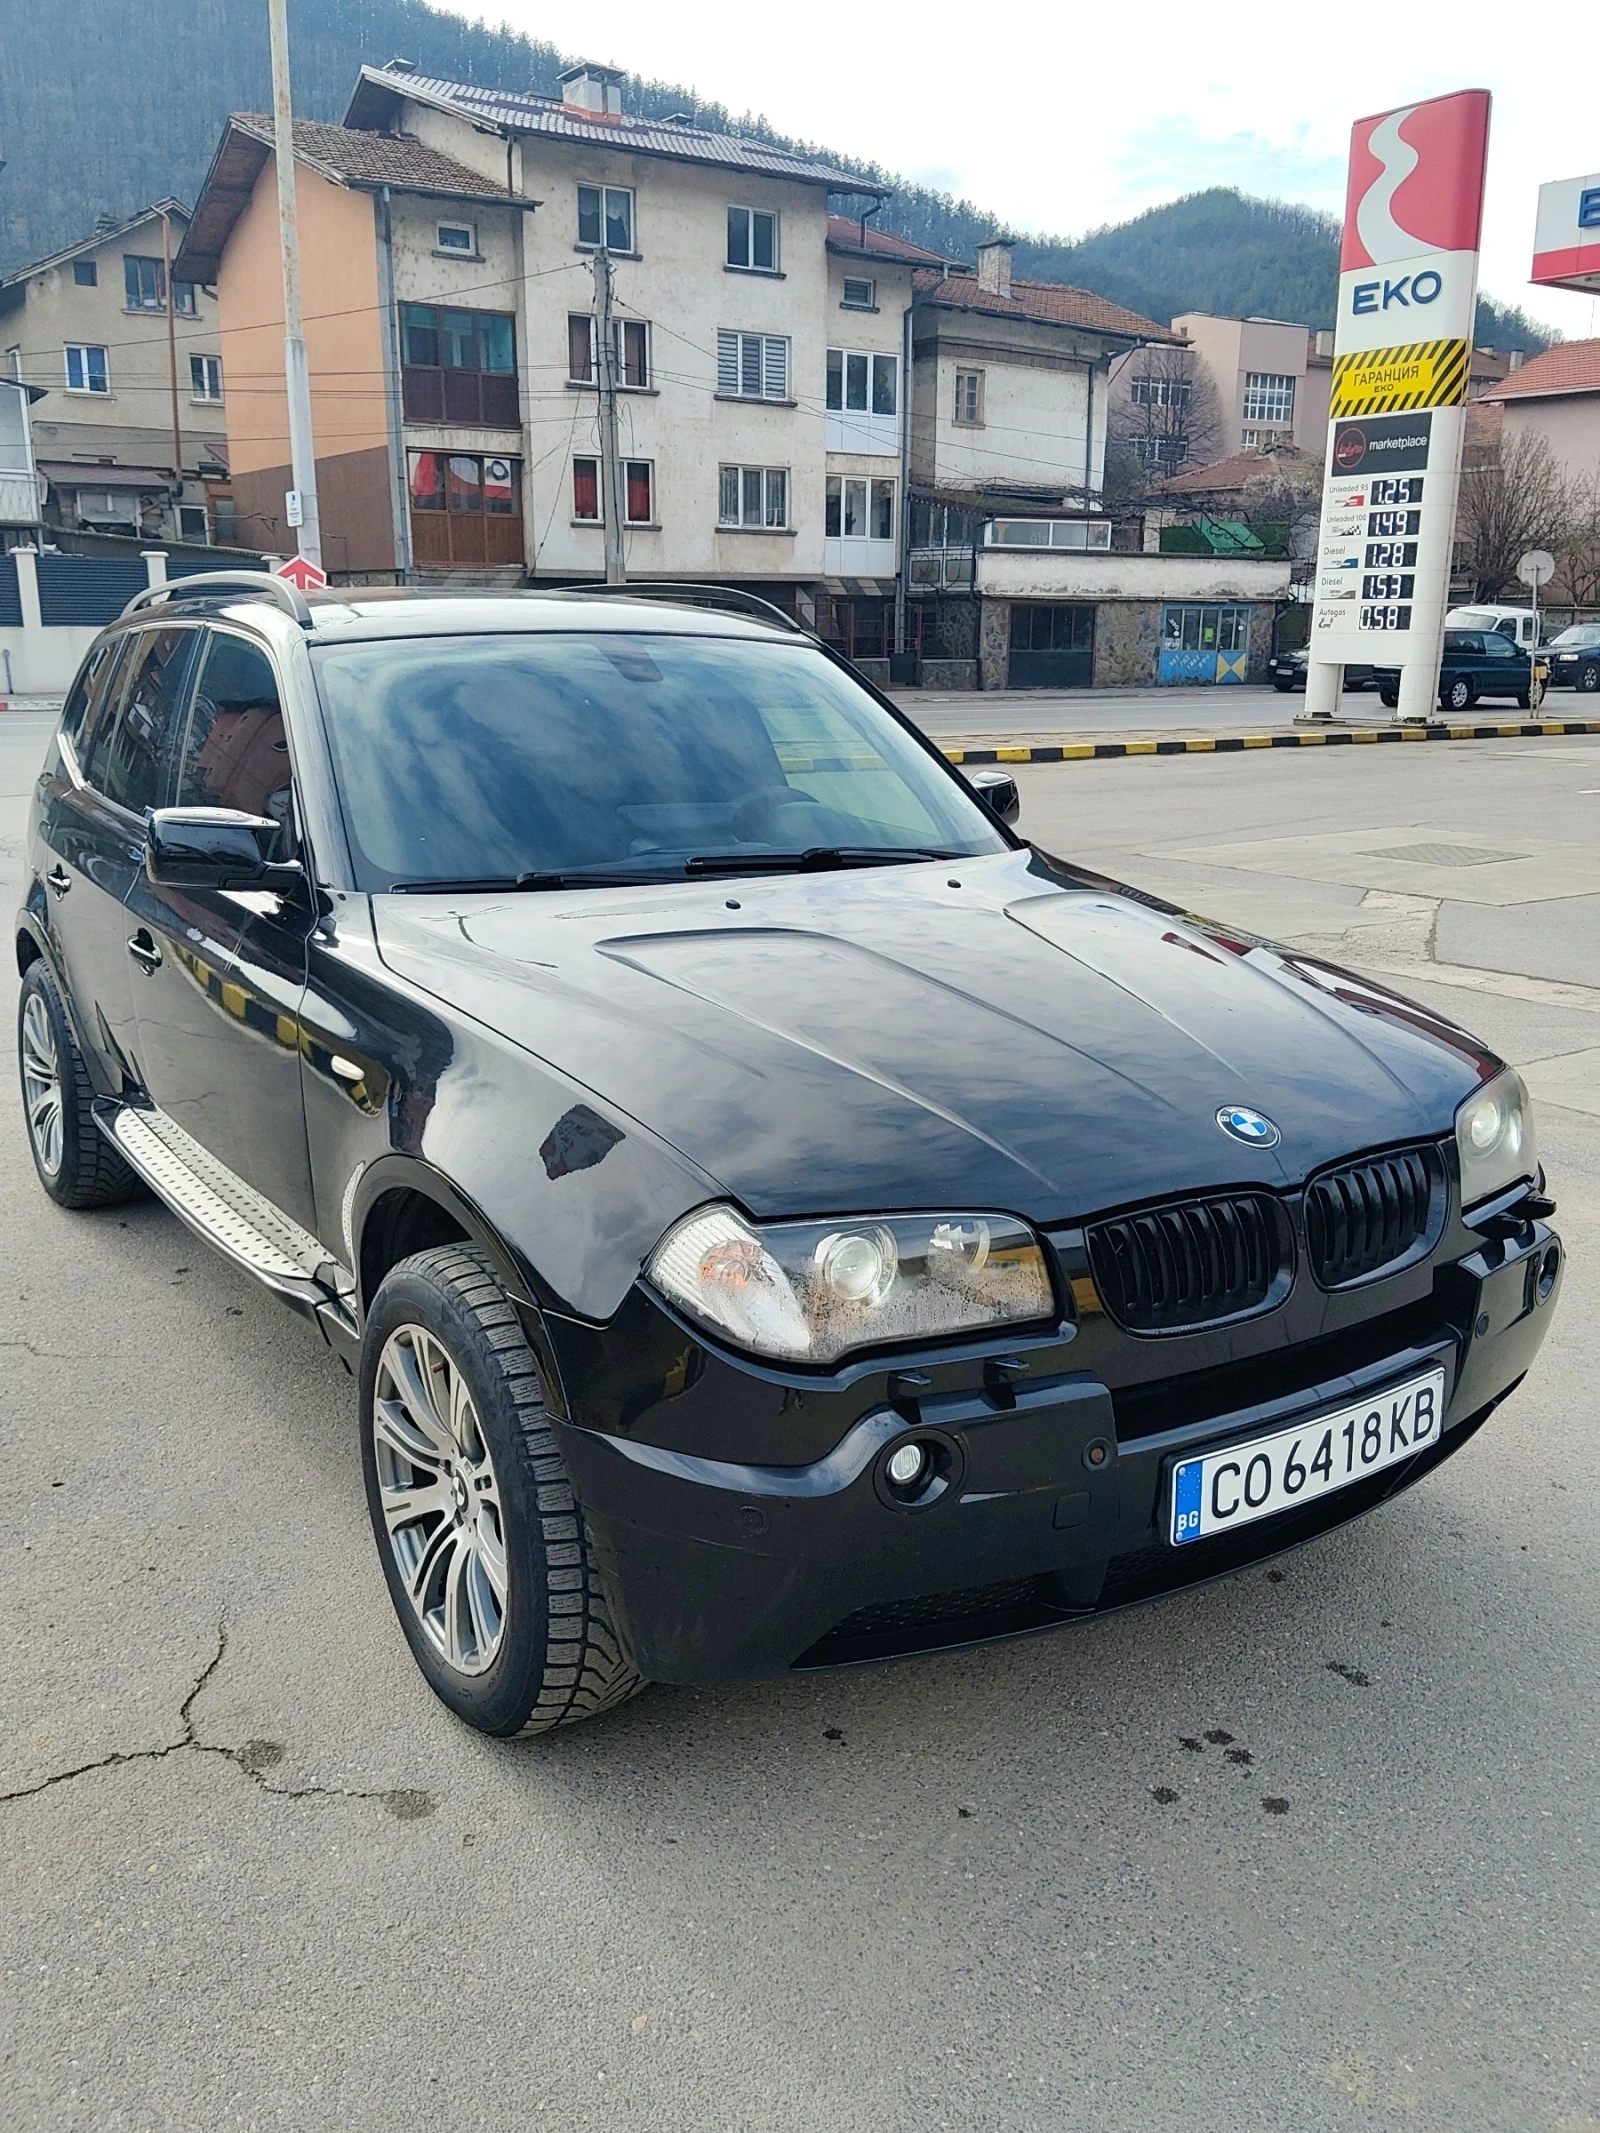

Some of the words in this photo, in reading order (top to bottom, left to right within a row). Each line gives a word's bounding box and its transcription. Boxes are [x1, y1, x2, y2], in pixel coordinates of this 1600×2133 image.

[1352, 270, 1442, 316] EKO
[1354, 365, 1419, 386] ГАРАНЦИЯ
[1369, 435, 1428, 451] marketplace
[1329, 484, 1359, 493] Unleaded
[1378, 478, 1410, 504] 1.25
[1326, 515, 1355, 523] Unleaded
[1375, 510, 1408, 535] 1.49
[1324, 545, 1346, 555] Diesel
[1372, 543, 1405, 567] 1.28
[1321, 577, 1343, 586] Diesel
[1369, 574, 1402, 598] 1.53
[1318, 608, 1346, 618] Autogas
[1360, 606, 1399, 630] 0.58
[1177, 1510, 1199, 1533] BG
